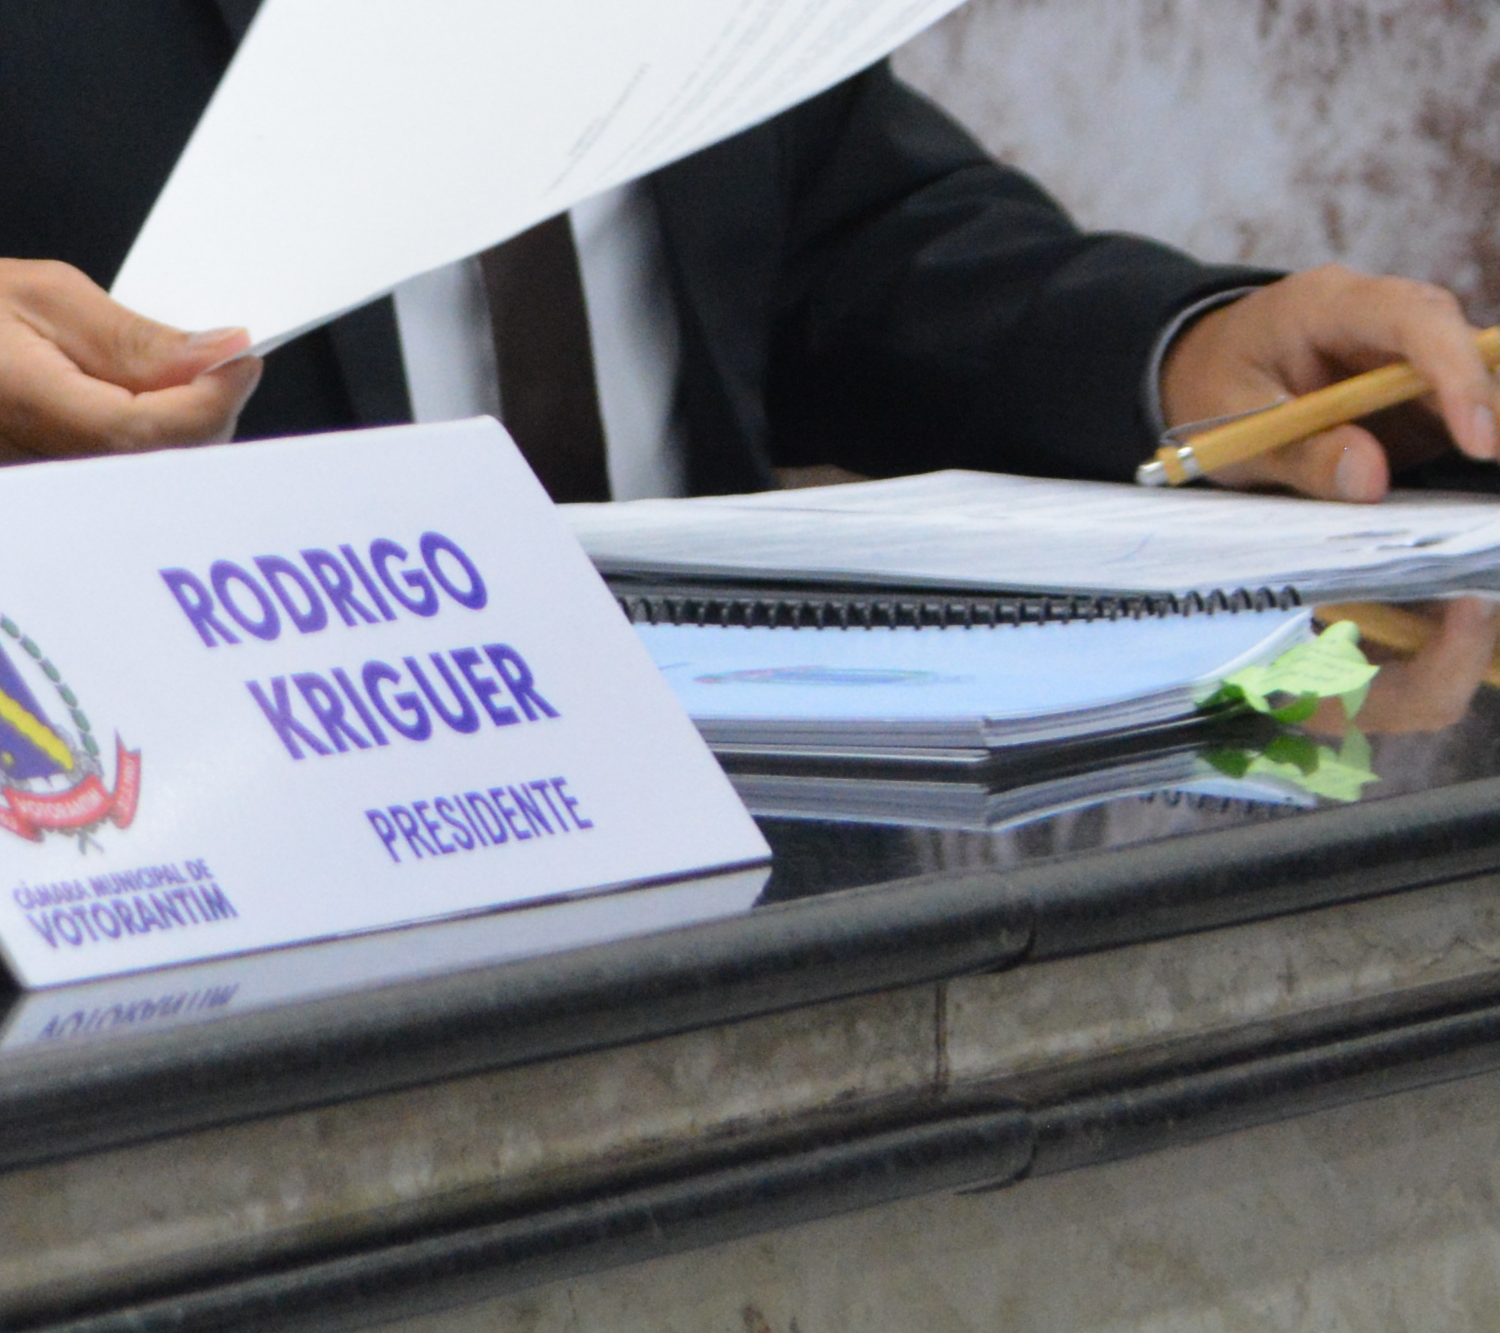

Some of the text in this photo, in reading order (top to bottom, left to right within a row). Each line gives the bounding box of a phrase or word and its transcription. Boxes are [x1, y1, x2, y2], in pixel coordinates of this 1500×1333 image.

[158, 531, 488, 647] RODRIGO
[244, 643, 561, 760] KRIGUER
[364, 775, 595, 863] PRESIDENTE
[13, 858, 214, 910] CÂMARA MUNICIPAL DE
[25, 882, 239, 948] VOTORANTIM
